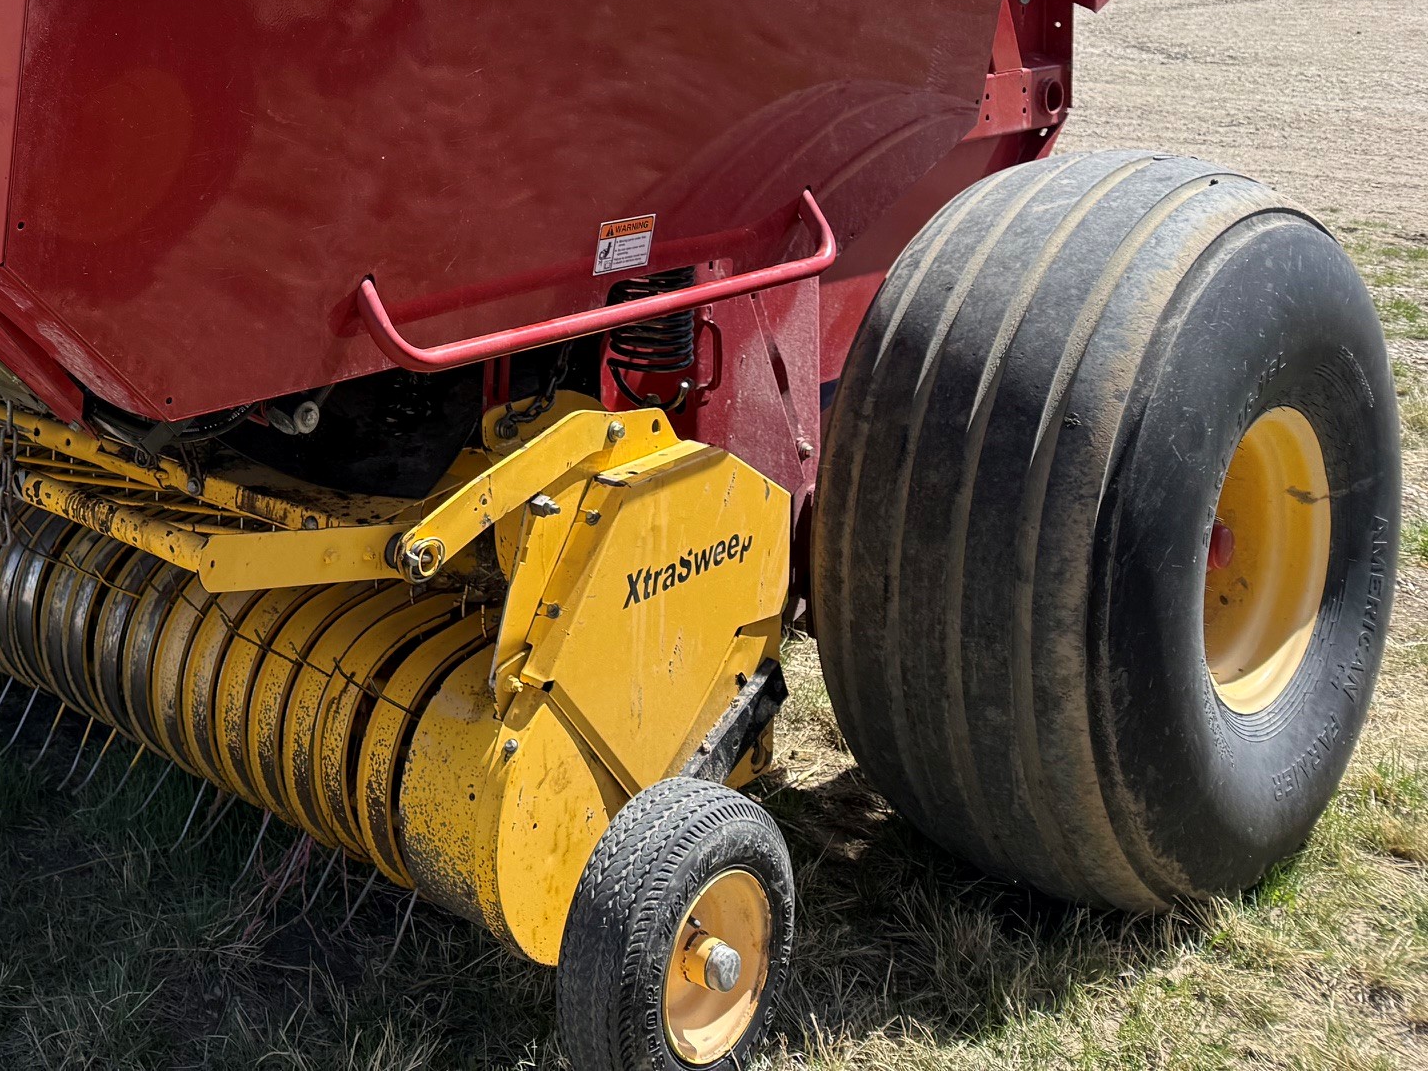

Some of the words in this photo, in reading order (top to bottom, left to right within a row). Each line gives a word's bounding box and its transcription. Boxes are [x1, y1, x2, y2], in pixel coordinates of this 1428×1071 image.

[615, 220, 649, 233] WARNING
[622, 533, 753, 610] XtraSweep
[1342, 515, 1389, 704] AMERICAN
[1271, 712, 1343, 802] FARMER
